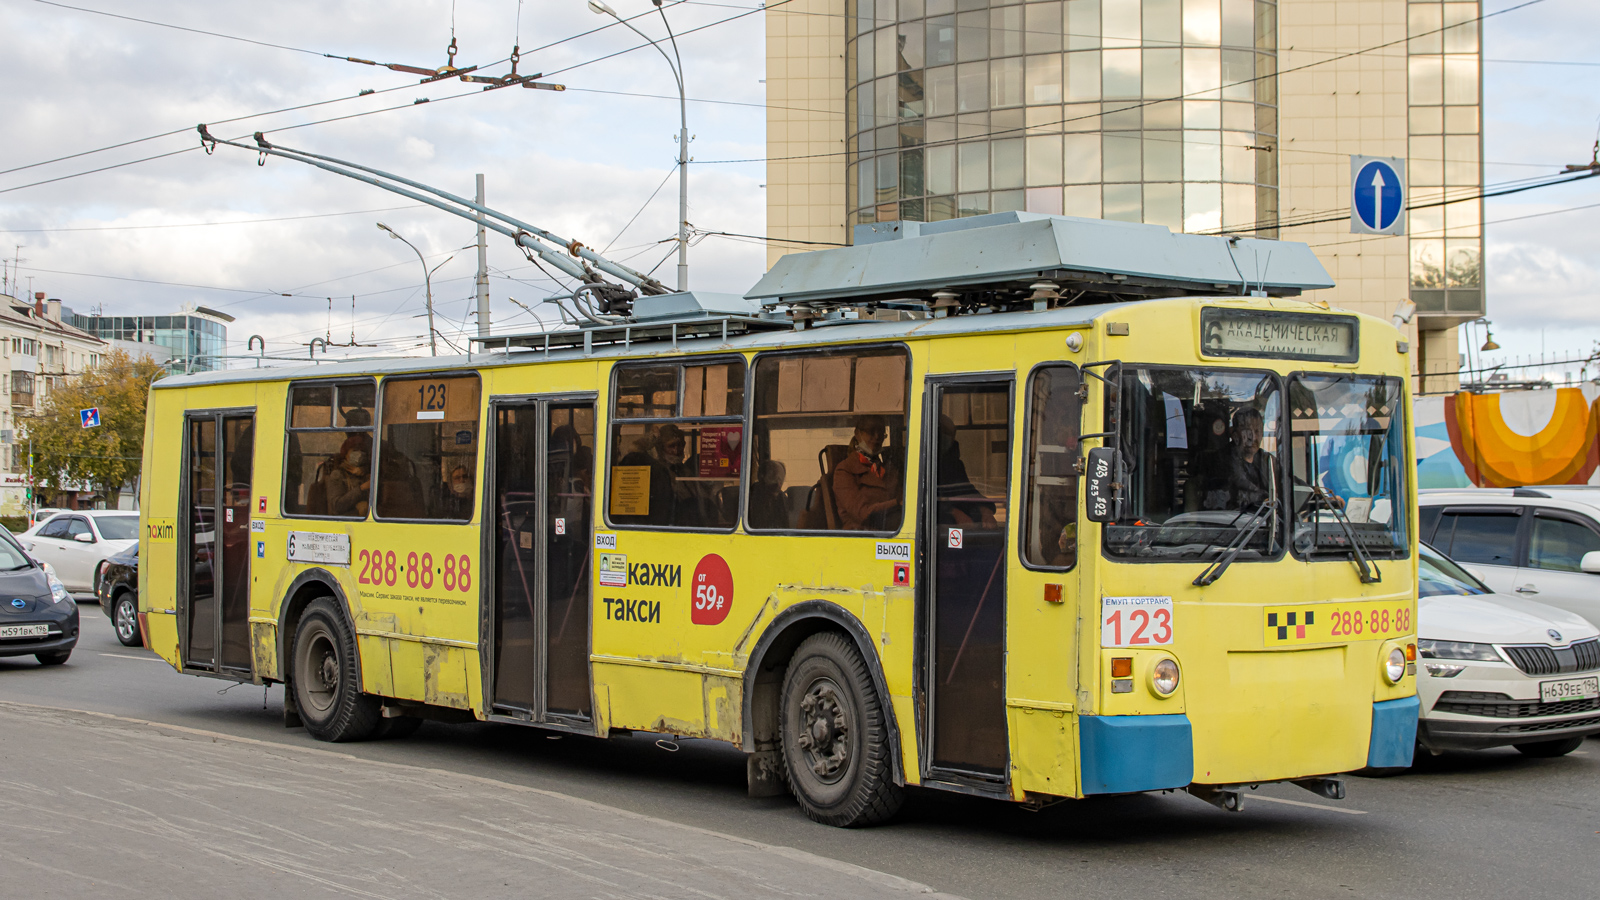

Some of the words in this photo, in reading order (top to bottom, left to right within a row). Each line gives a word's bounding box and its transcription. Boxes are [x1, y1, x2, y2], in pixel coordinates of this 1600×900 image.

[1205, 320, 1223, 350] 6
[1227, 321, 1339, 343] АКАДЕМИЧЕСКАЯ
[418, 383, 446, 410] 123
[289, 534, 296, 557] 6
[596, 535, 615, 547] ВХОД
[877, 544, 909, 557] ВЫХОД
[602, 597, 660, 624] такси
[1105, 598, 1128, 606] ЕМУП
[1131, 597, 1170, 605] ГОРТРАНС
[35, 625, 47, 633] 196
[1106, 608, 1172, 645] 123
